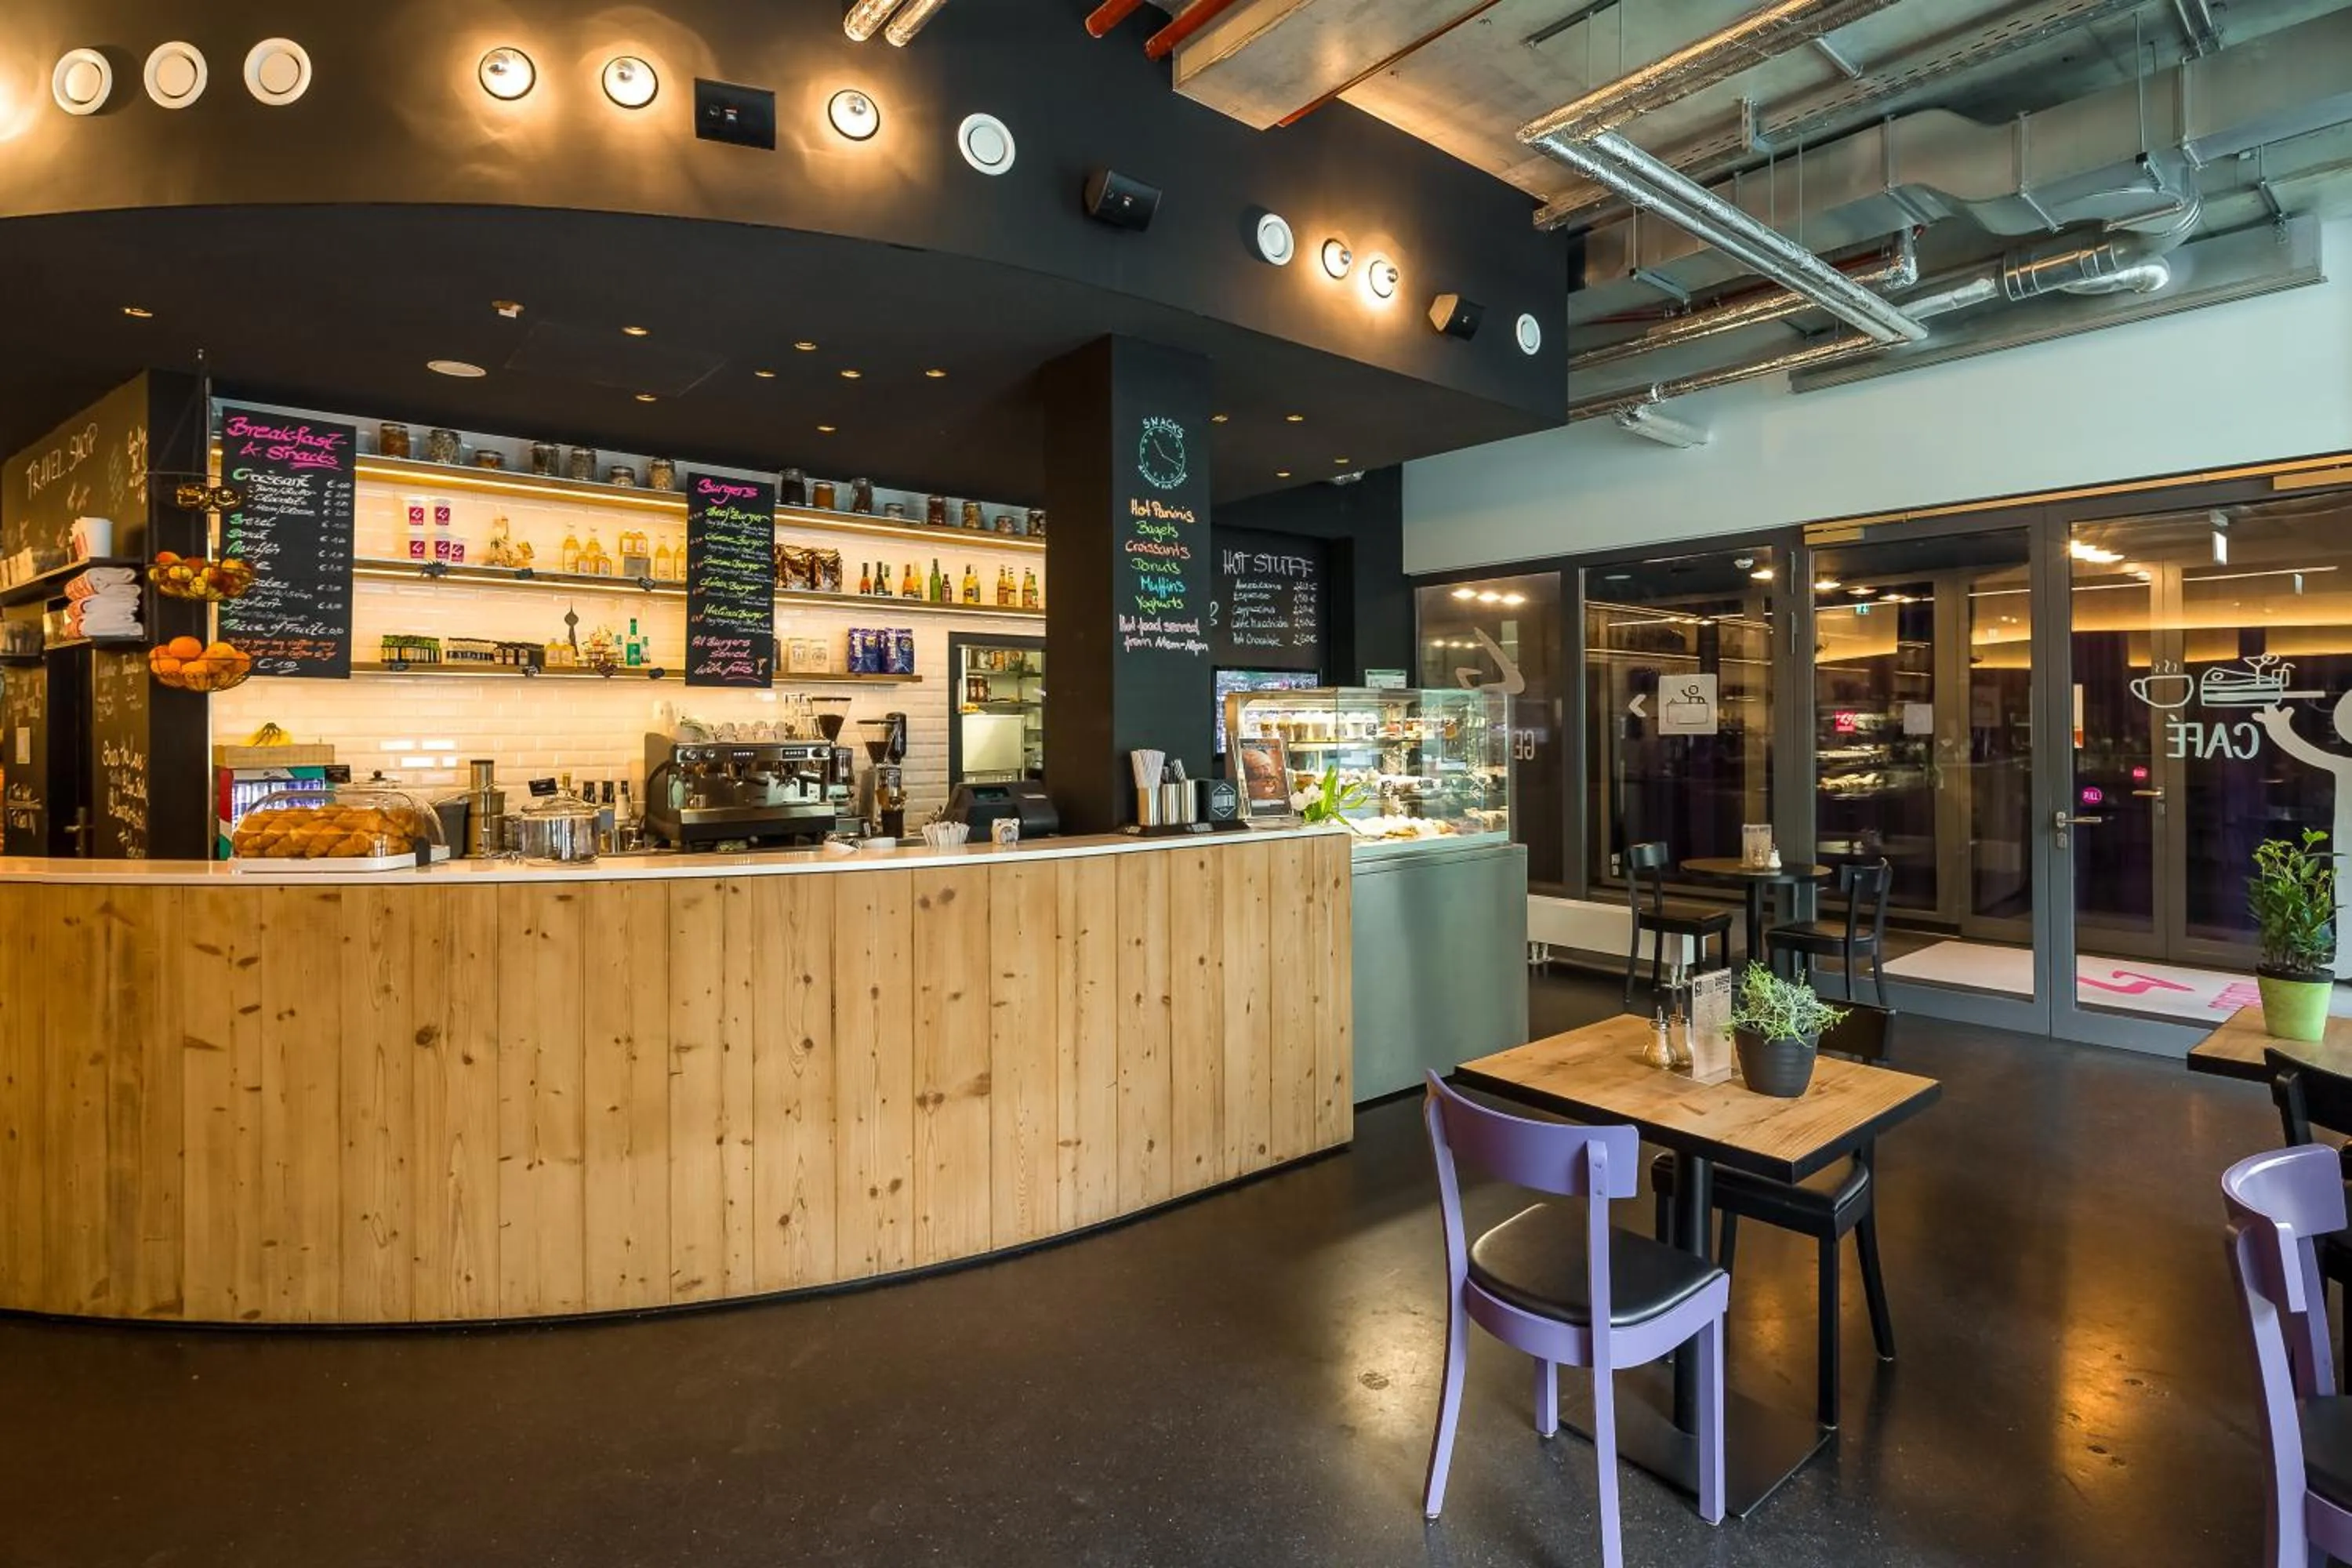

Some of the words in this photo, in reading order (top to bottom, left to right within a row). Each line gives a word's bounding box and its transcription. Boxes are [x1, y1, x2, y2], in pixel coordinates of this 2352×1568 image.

[227, 416, 347, 450] Breakfast
[1142, 416, 1186, 438] SNACKS
[26, 448, 66, 500] TRAVEL
[69, 423, 98, 472] SHOP
[240, 441, 263, 457] &
[267, 445, 339, 464] Snacks
[698, 478, 758, 503] Burgers
[1131, 498, 1151, 517] Hot
[1152, 501, 1195, 523] Paninis
[1135, 520, 1179, 543] Bagels
[1125, 540, 1191, 559] Croissants
[1131, 557, 1181, 574] Donuts
[1223, 550, 1252, 574] HOT
[1254, 553, 1314, 578] STUFF
[1141, 575, 1186, 598] Muffins
[1135, 596, 1185, 615] Yoghurts
[1136, 617, 1162, 636] food
[1124, 635, 1152, 653] from
